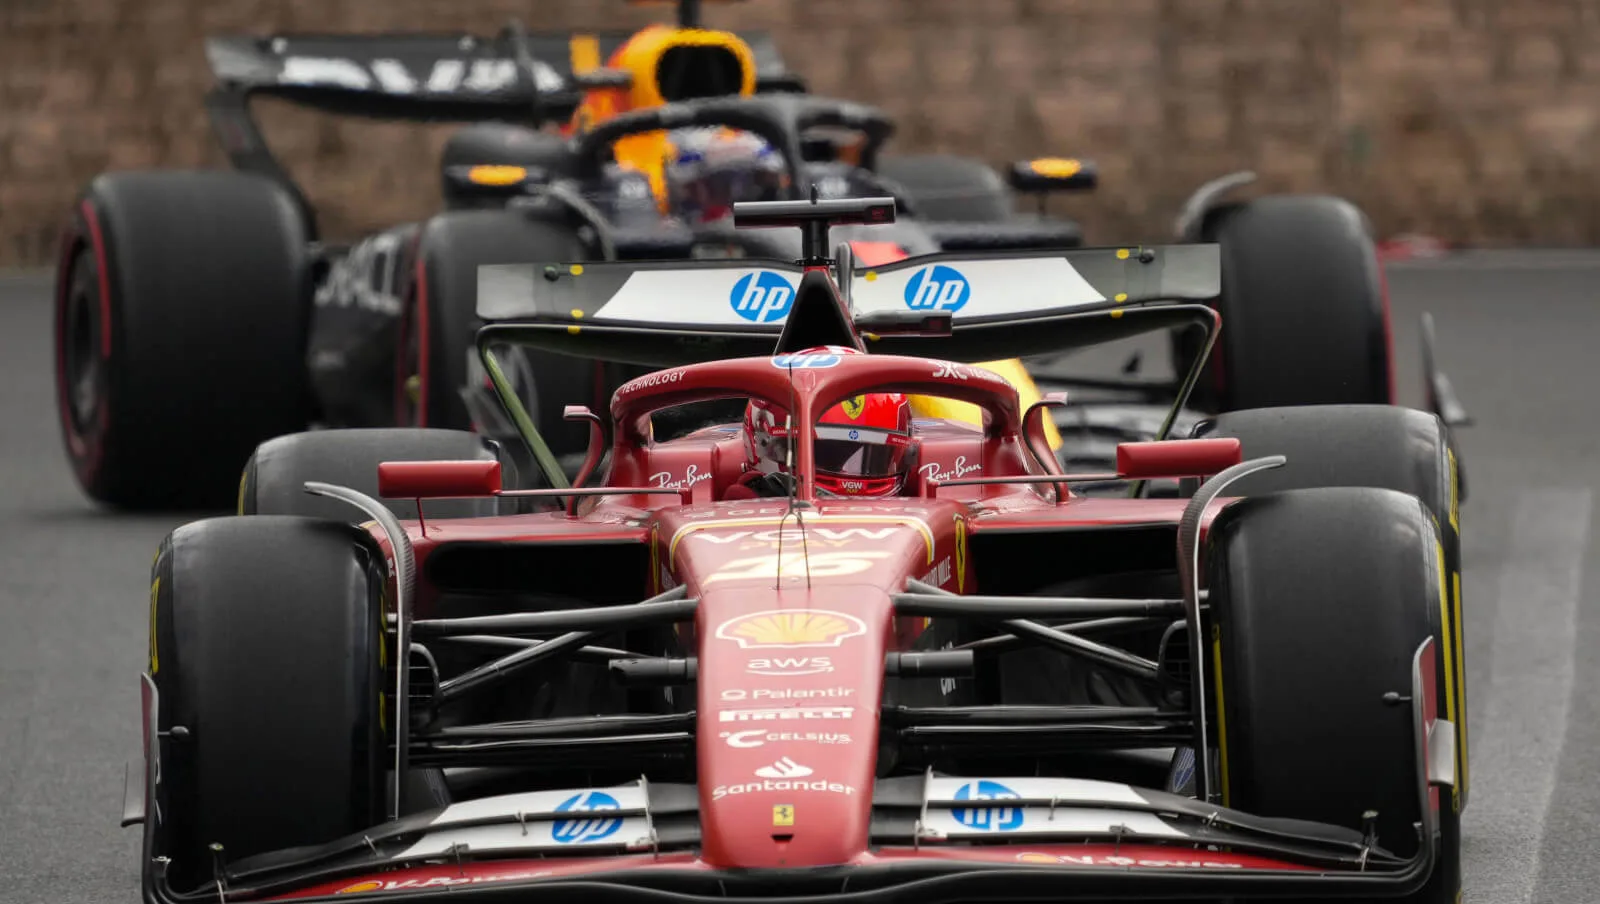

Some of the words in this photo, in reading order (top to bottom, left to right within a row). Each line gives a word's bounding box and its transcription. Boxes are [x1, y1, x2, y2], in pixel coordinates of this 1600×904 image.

[736, 271, 791, 322] hp
[911, 265, 965, 314] hp
[622, 371, 686, 394] TECHNOLOGY
[649, 464, 713, 489] Ray-Ban
[918, 456, 982, 482] Ray-Ban
[842, 481, 862, 489] VGW
[693, 528, 900, 544] VGW
[747, 656, 832, 670] aws
[752, 687, 856, 699] Palantir
[719, 706, 855, 722] PIRELLI
[766, 732, 853, 743] CELSIUS
[712, 780, 856, 800] Santander
